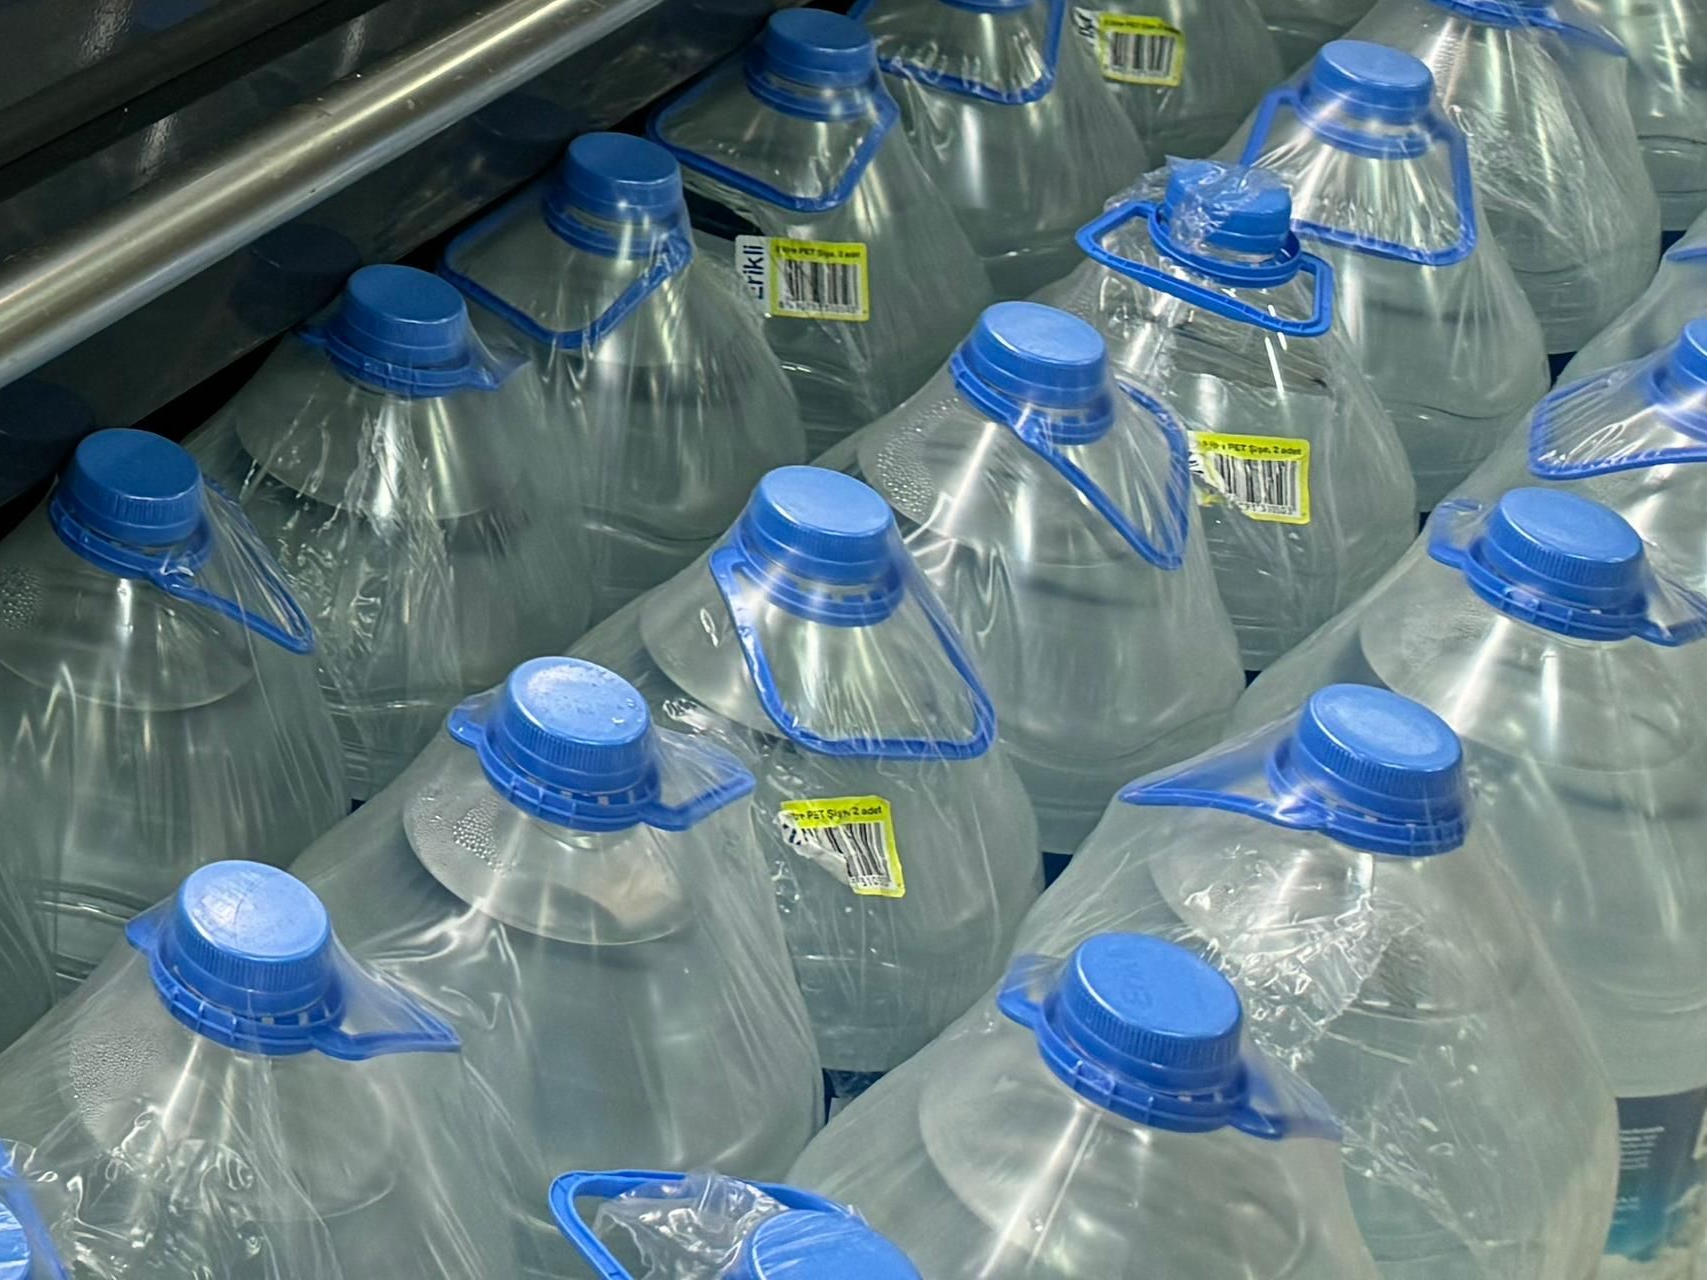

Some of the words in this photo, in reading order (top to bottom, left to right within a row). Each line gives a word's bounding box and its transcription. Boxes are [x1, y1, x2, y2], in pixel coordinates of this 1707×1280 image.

[1228, 443, 1247, 453] PET
[1273, 446, 1280, 454] 2
[1281, 446, 1302, 456] adet
[807, 809, 826, 820] PET
[852, 806, 860, 816] 2
[861, 805, 882, 815] adet
